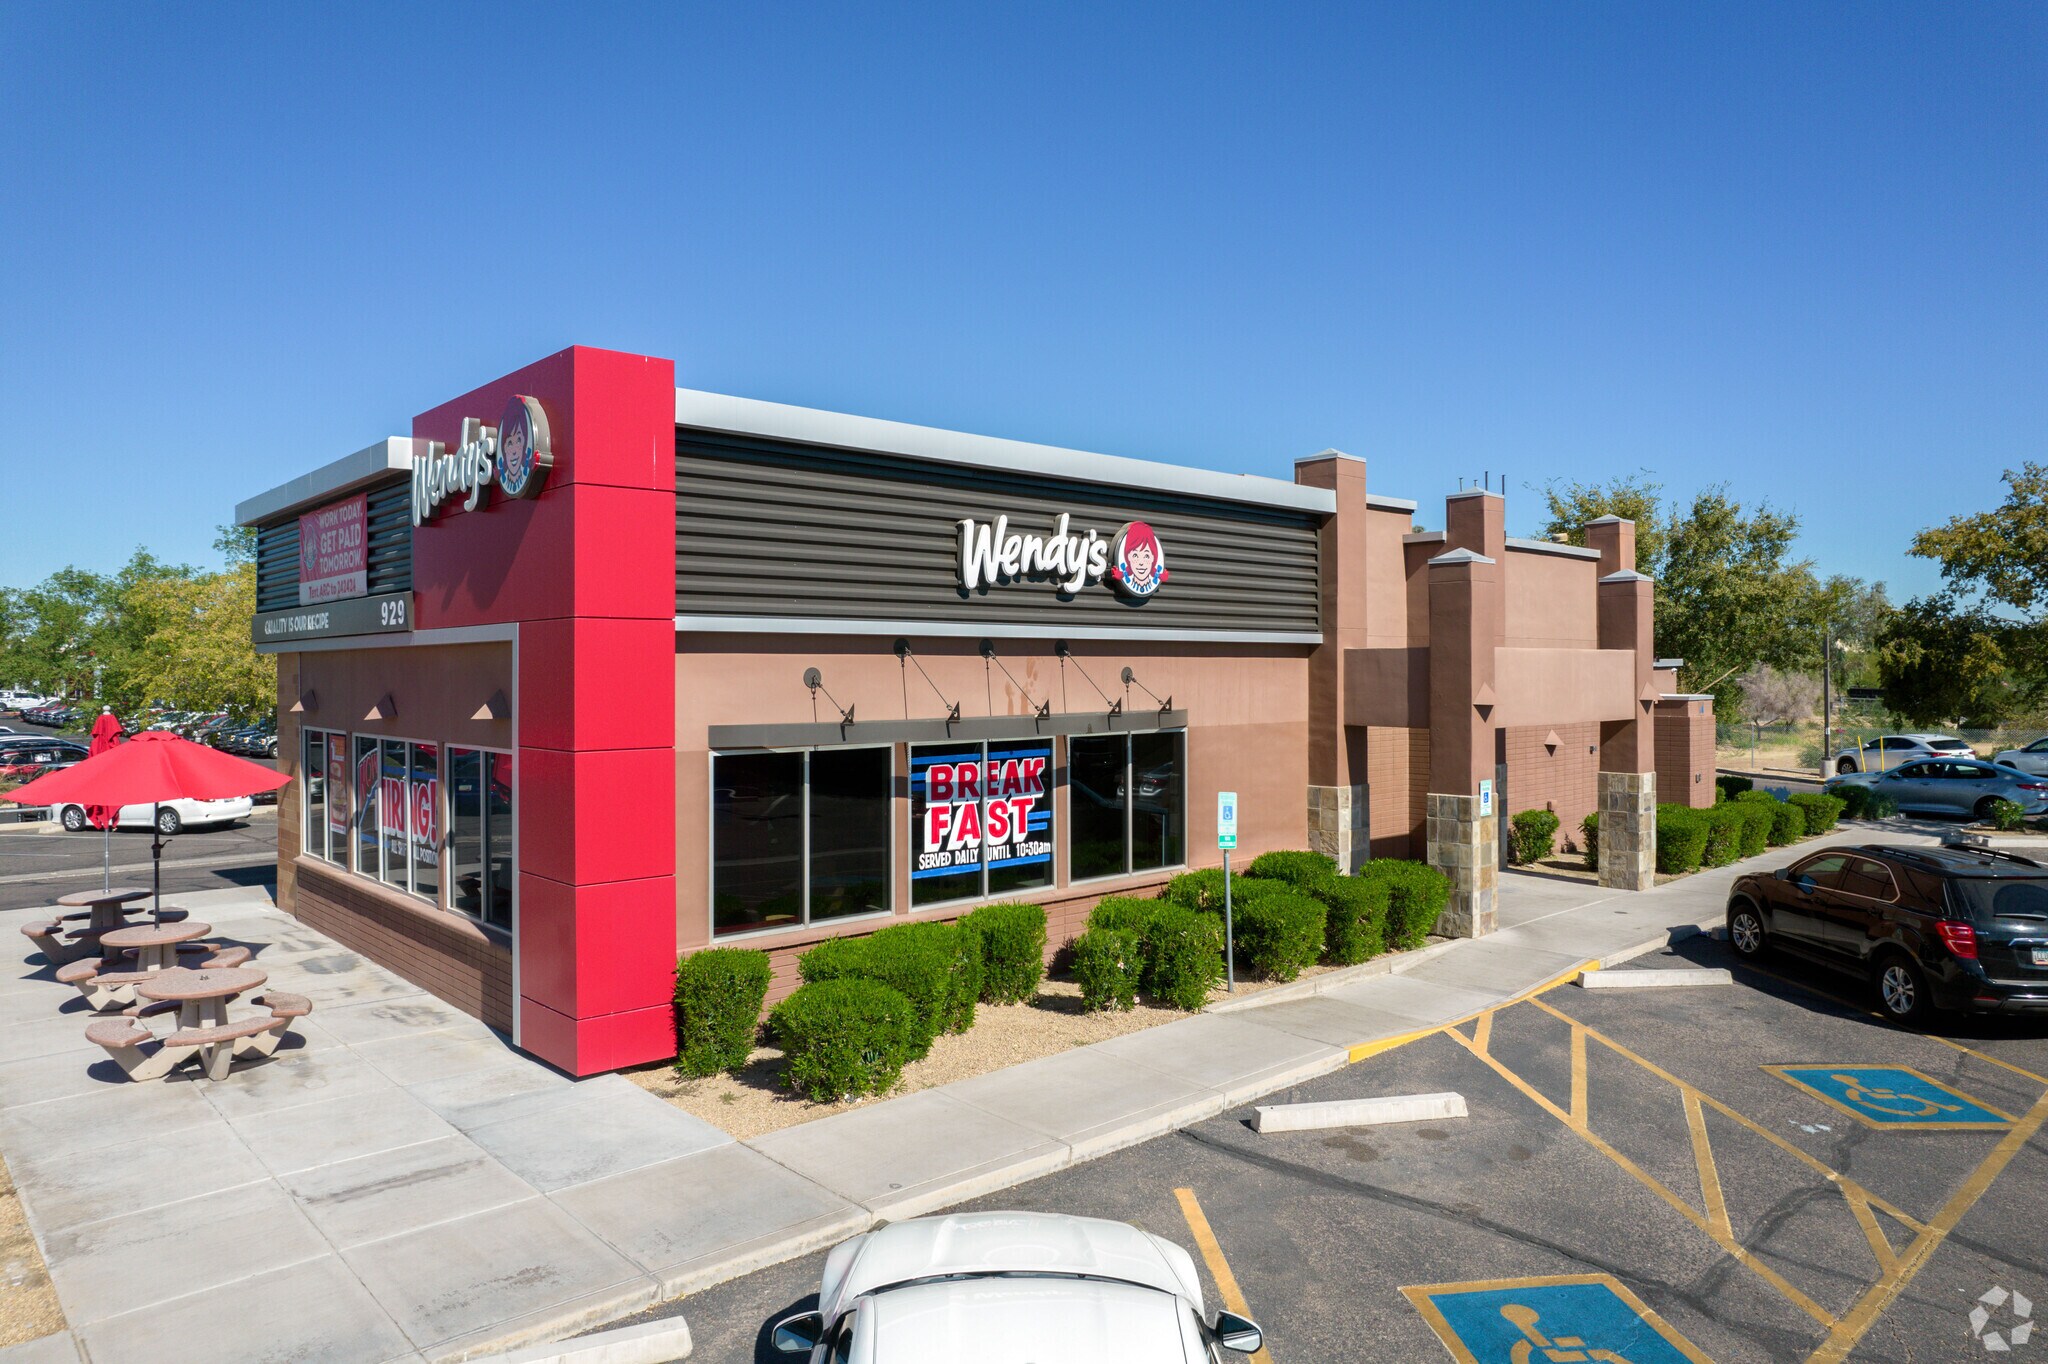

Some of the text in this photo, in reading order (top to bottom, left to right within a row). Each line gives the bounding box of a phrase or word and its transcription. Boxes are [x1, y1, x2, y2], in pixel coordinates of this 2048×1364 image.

[412, 416, 495, 528] Wendy's
[319, 501, 363, 528] WORK TODAY.
[320, 523, 361, 555] GET PAID
[959, 512, 1107, 593] Wendy's
[319, 548, 363, 574] TOMORROW.
[264, 612, 330, 635] QUALITY IS OUR RECIPE
[381, 600, 405, 626] 929
[927, 758, 1045, 804] BREAK
[927, 798, 1034, 849] FAST
[919, 842, 1051, 870] SERVED DAILY UNTIL 10:30am
